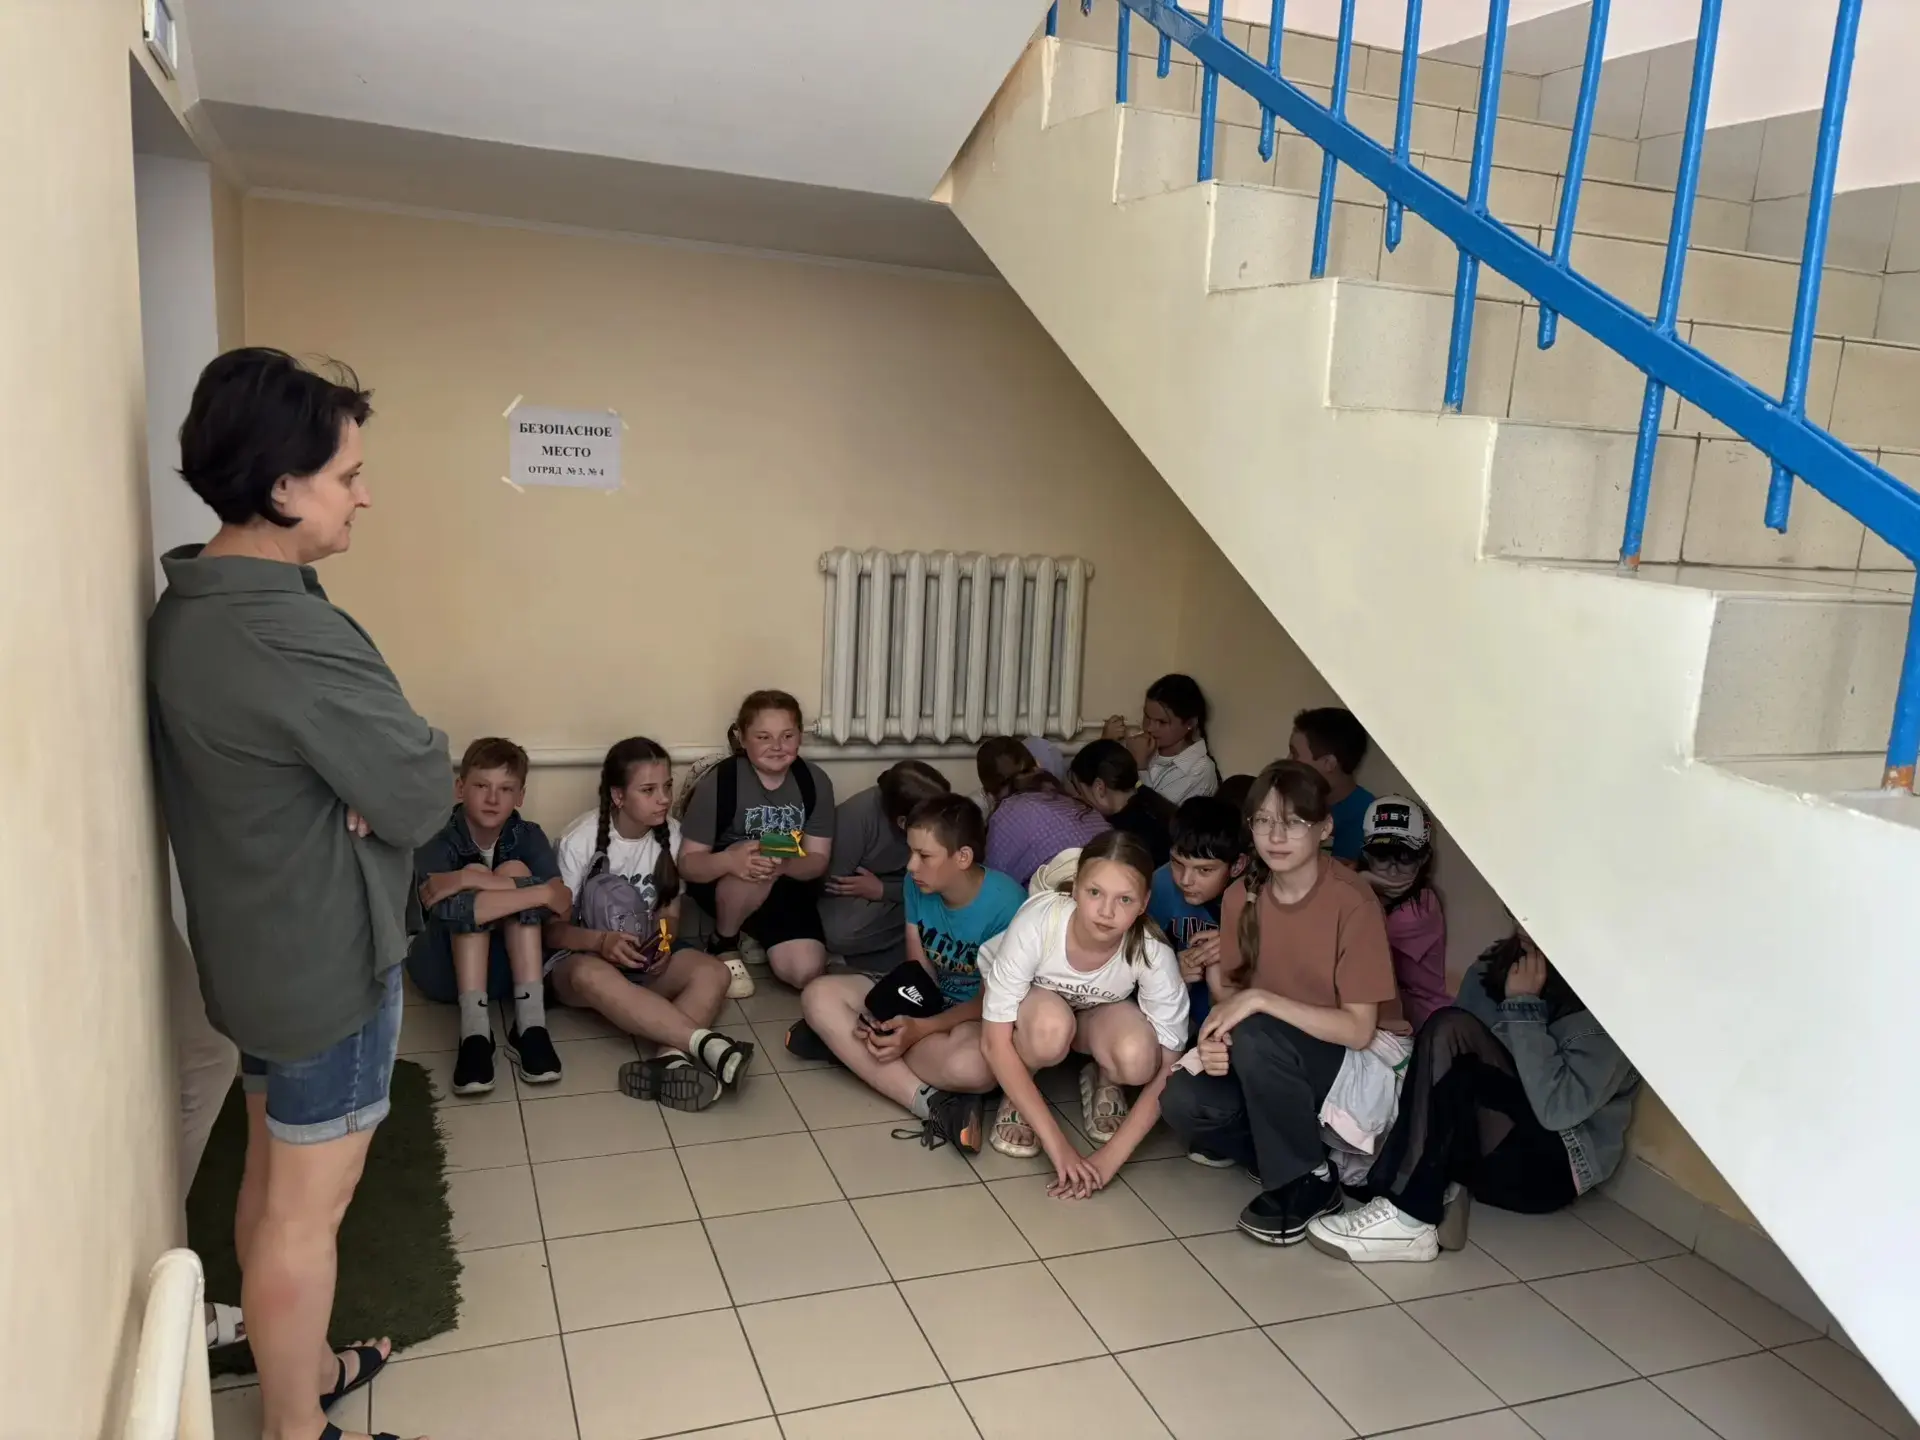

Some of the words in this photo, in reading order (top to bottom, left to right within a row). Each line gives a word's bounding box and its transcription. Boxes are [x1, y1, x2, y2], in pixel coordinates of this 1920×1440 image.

[519, 422, 612, 438] БЕЗОПАСНОЕ
[541, 445, 591, 458] МЕСТО
[528, 465, 562, 475] ОТРЯД
[905, 985, 924, 1002] NIKE
